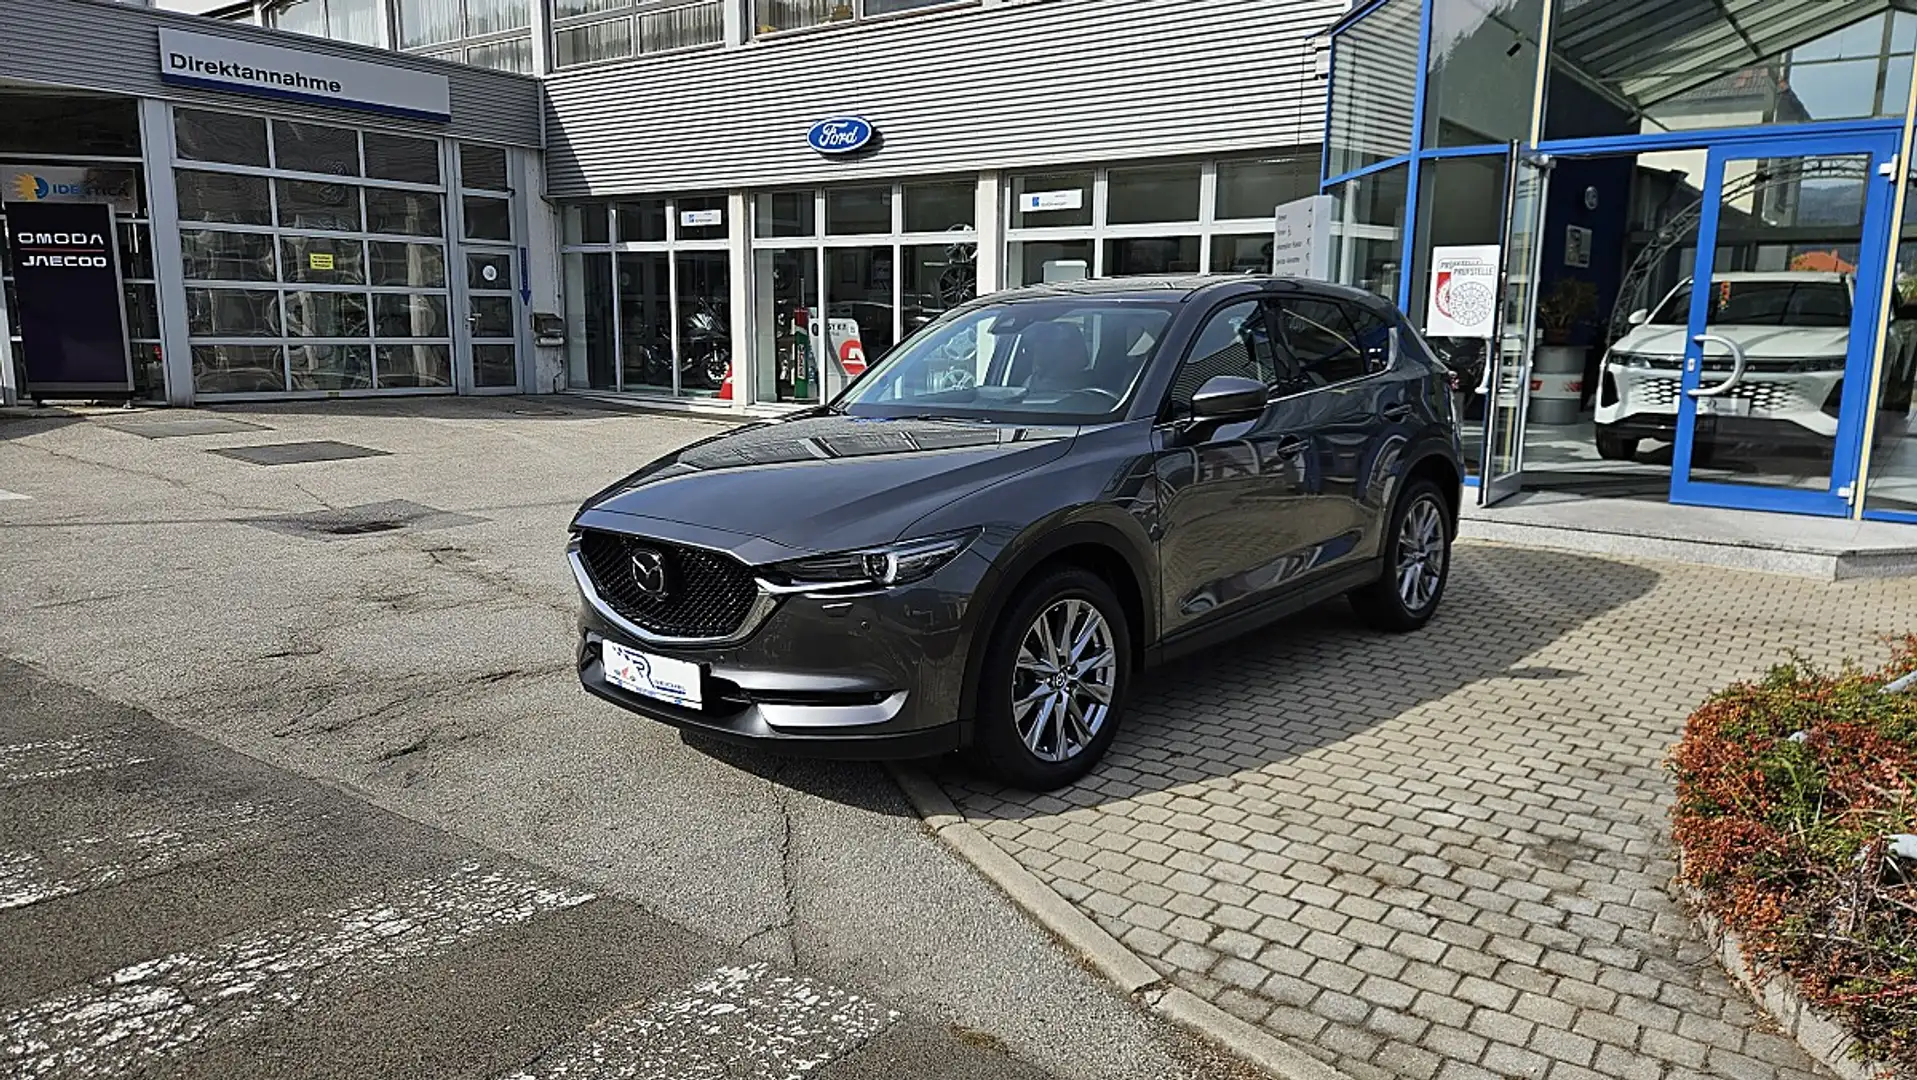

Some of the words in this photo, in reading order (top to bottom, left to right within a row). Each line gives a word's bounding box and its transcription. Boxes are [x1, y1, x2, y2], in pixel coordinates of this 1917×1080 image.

[169, 52, 342, 93] Direktannahme
[818, 121, 859, 147] Ford
[17, 232, 104, 245] OMODA
[21, 255, 107, 268] JAECOO
